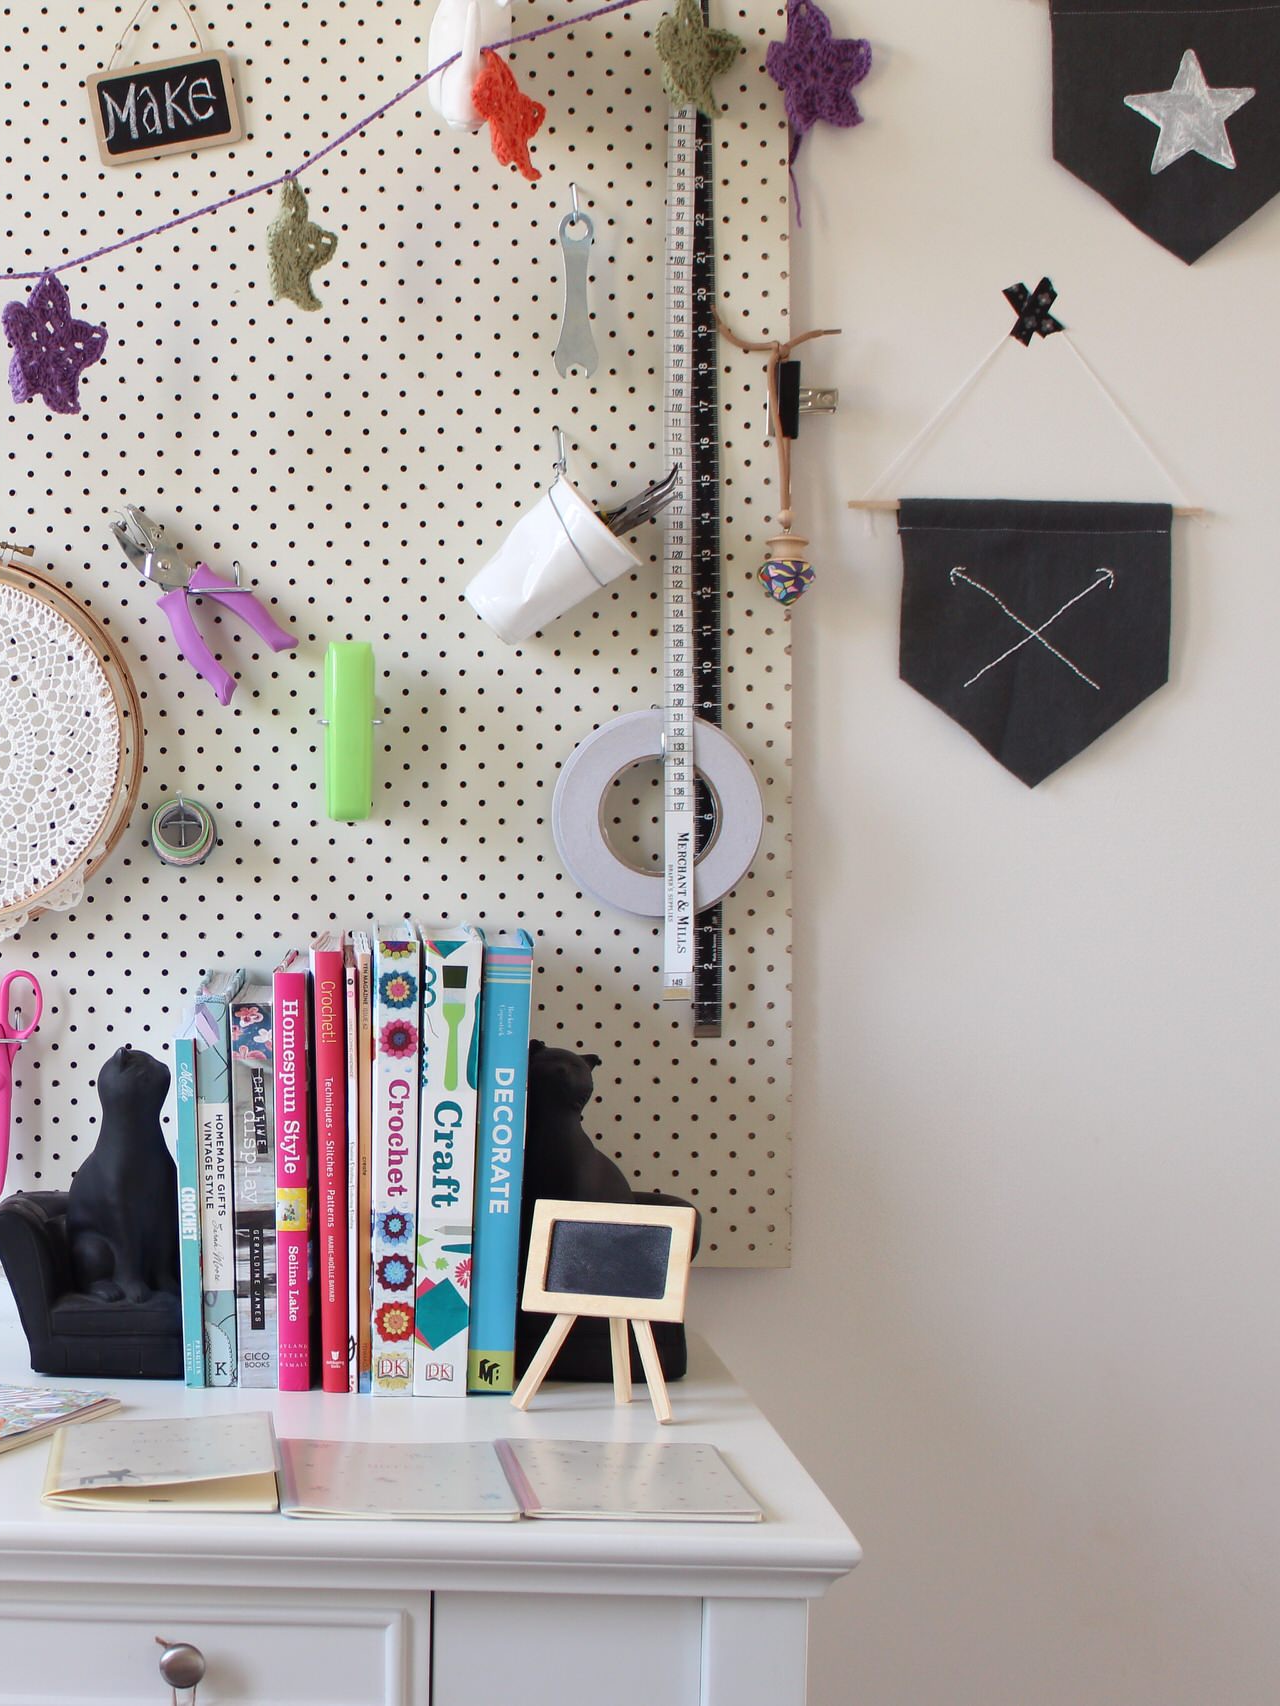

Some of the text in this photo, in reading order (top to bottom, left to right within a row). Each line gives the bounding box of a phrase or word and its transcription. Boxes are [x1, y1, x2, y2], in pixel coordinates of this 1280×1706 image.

[102, 75, 217, 142] Make
[677, 832, 690, 897] MERCHANT
[677, 917, 690, 954] MILLS
[320, 980, 337, 1043] Crochet!
[179, 1062, 194, 1103] Mollie
[253, 1076, 267, 1147] CREATIVE
[279, 999, 300, 1174] Homespun Style
[324, 1077, 333, 1129] Techniques
[204, 1121, 214, 1209] VINTAGE STYLE
[215, 1113, 226, 1216] HOMEMADE GIFTS
[240, 1110, 261, 1203] display
[326, 1140, 335, 1178] Stitches
[386, 1079, 411, 1197] Crochet
[431, 1100, 463, 1209] Craft
[488, 1067, 516, 1214] DECORATE
[181, 1187, 197, 1241] CROCHET
[327, 1189, 336, 1228] Patterns
[252, 1229, 262, 1323] GERALDINE JAMES
[288, 1246, 300, 1323] Selina Lake
[215, 1362, 227, 1376] K
[244, 1352, 270, 1361] CICO
[380, 1359, 407, 1378] DK
[427, 1363, 450, 1380] DK
